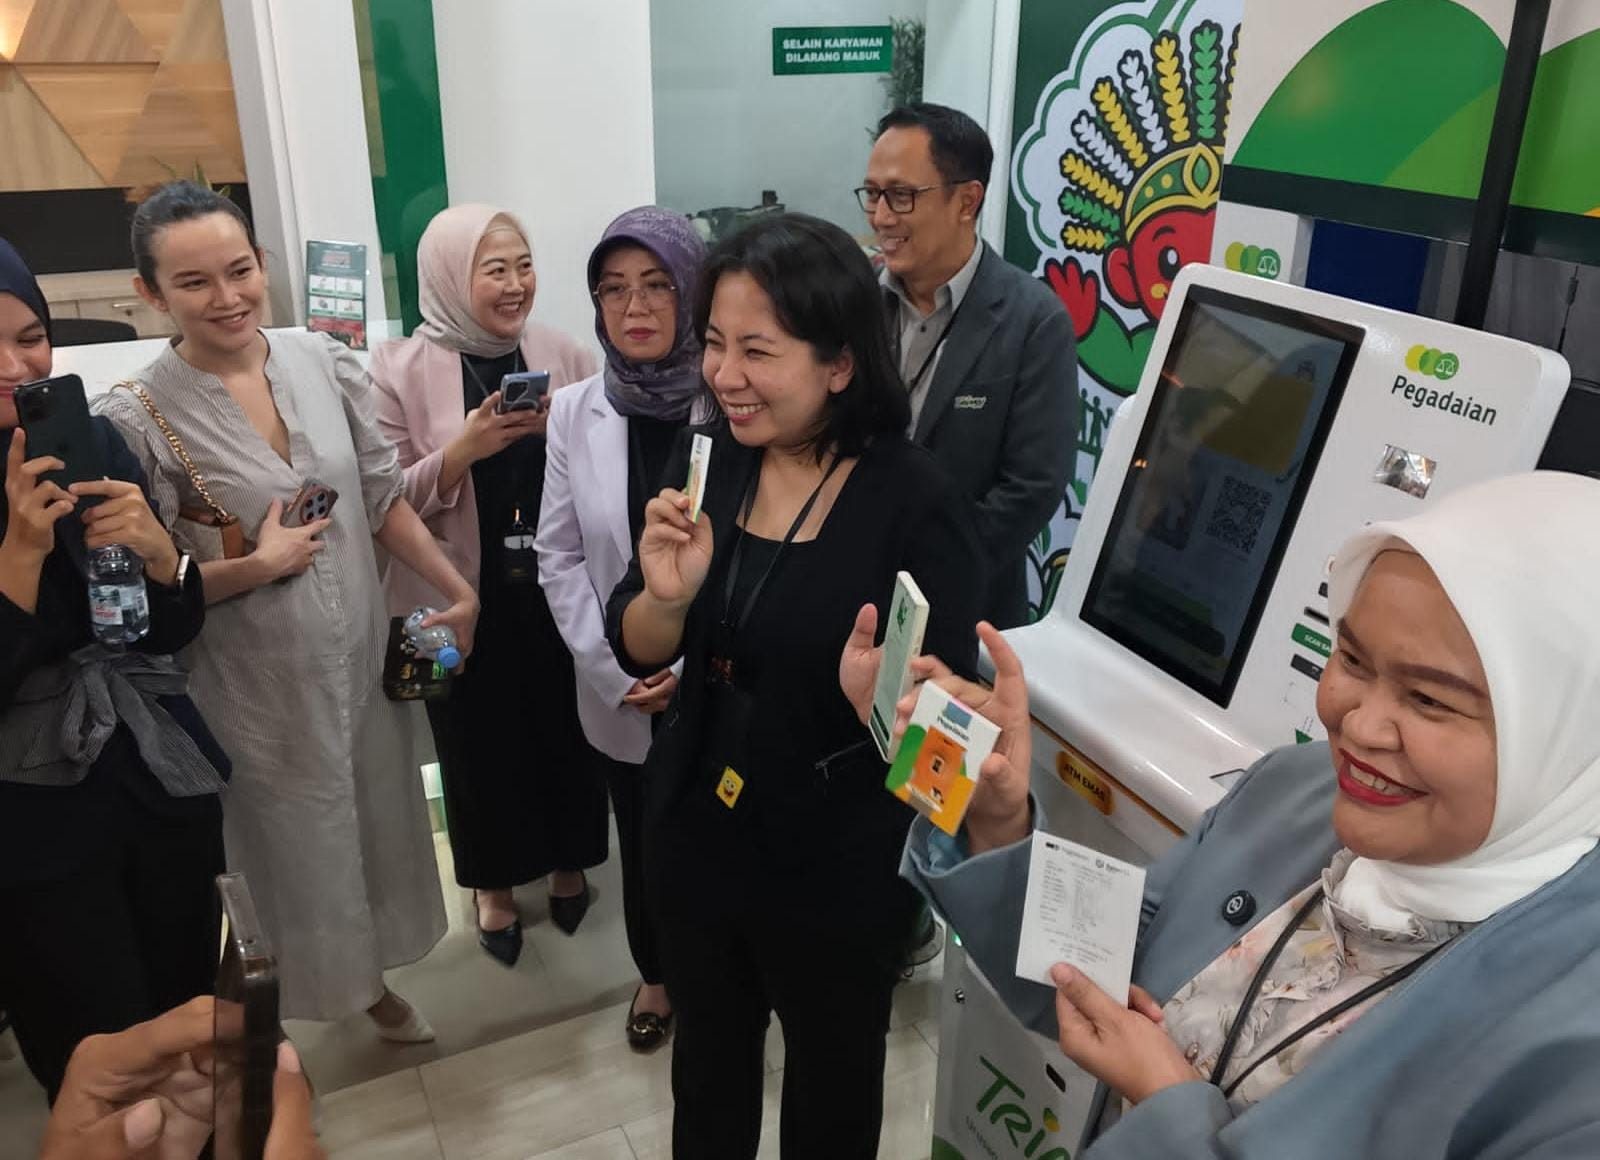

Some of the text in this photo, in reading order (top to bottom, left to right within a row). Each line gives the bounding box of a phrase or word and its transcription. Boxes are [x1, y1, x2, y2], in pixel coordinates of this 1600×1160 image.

[783, 37, 883, 49] SELAIN KARYAWAN
[785, 50, 880, 62] DILARANG MASUK
[1391, 374, 1497, 426] Pegadaian
